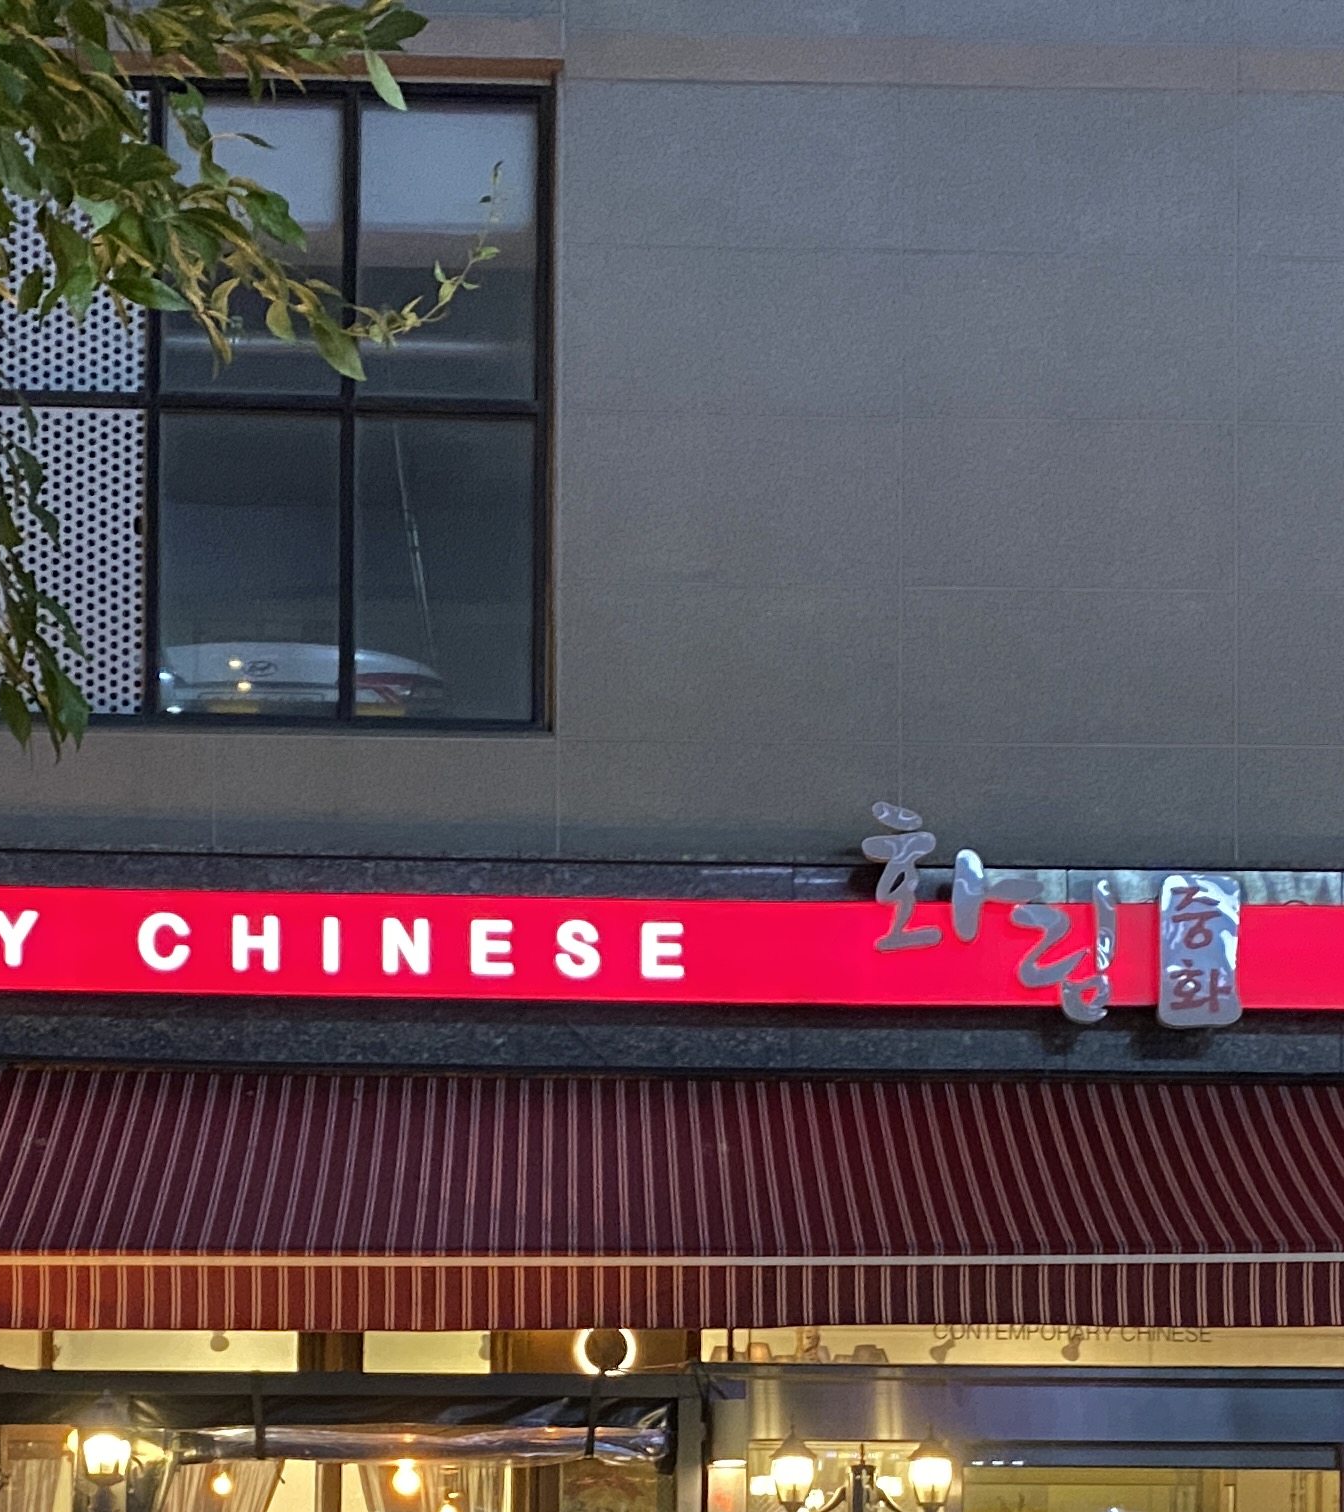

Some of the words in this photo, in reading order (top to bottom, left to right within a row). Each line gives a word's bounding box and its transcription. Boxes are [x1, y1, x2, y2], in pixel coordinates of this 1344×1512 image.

[136, 911, 686, 980] CHINESE
[861, 801, 1118, 1025] 화림
[1167, 884, 1237, 1014] 중화
